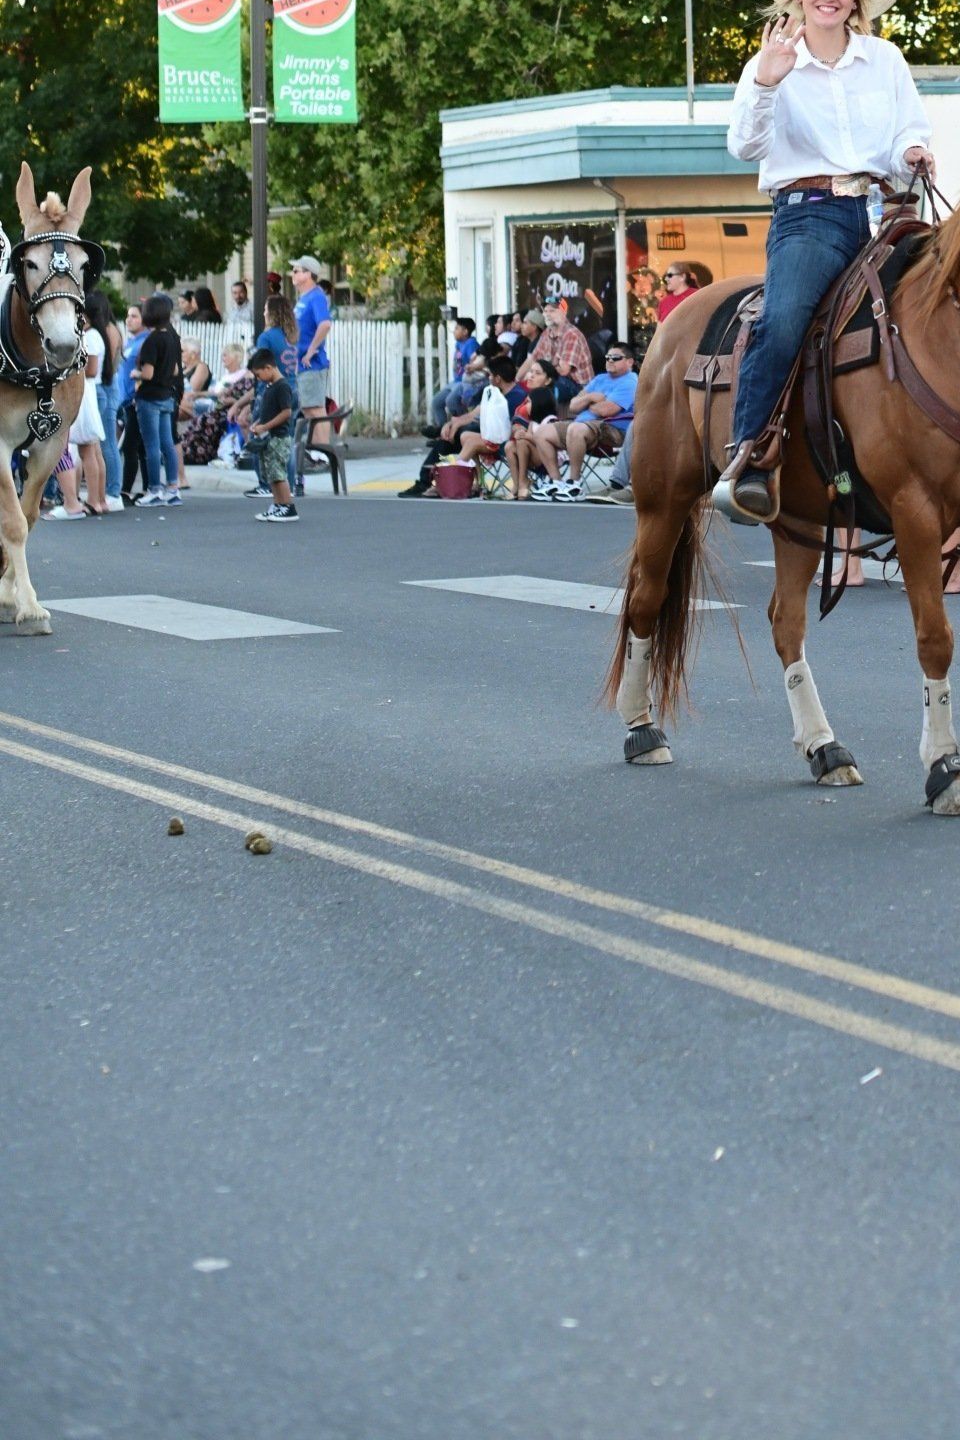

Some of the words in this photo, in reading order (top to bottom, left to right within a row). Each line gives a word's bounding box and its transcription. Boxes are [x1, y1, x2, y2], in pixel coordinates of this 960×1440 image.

[280, 54, 350, 73] Jimmy's
[163, 64, 221, 86] Bruce
[289, 70, 340, 85] Johns
[280, 85, 351, 101] Portable
[289, 101, 343, 116] Toilets
[540, 235, 585, 269] Styling
[546, 272, 578, 298] Diva
